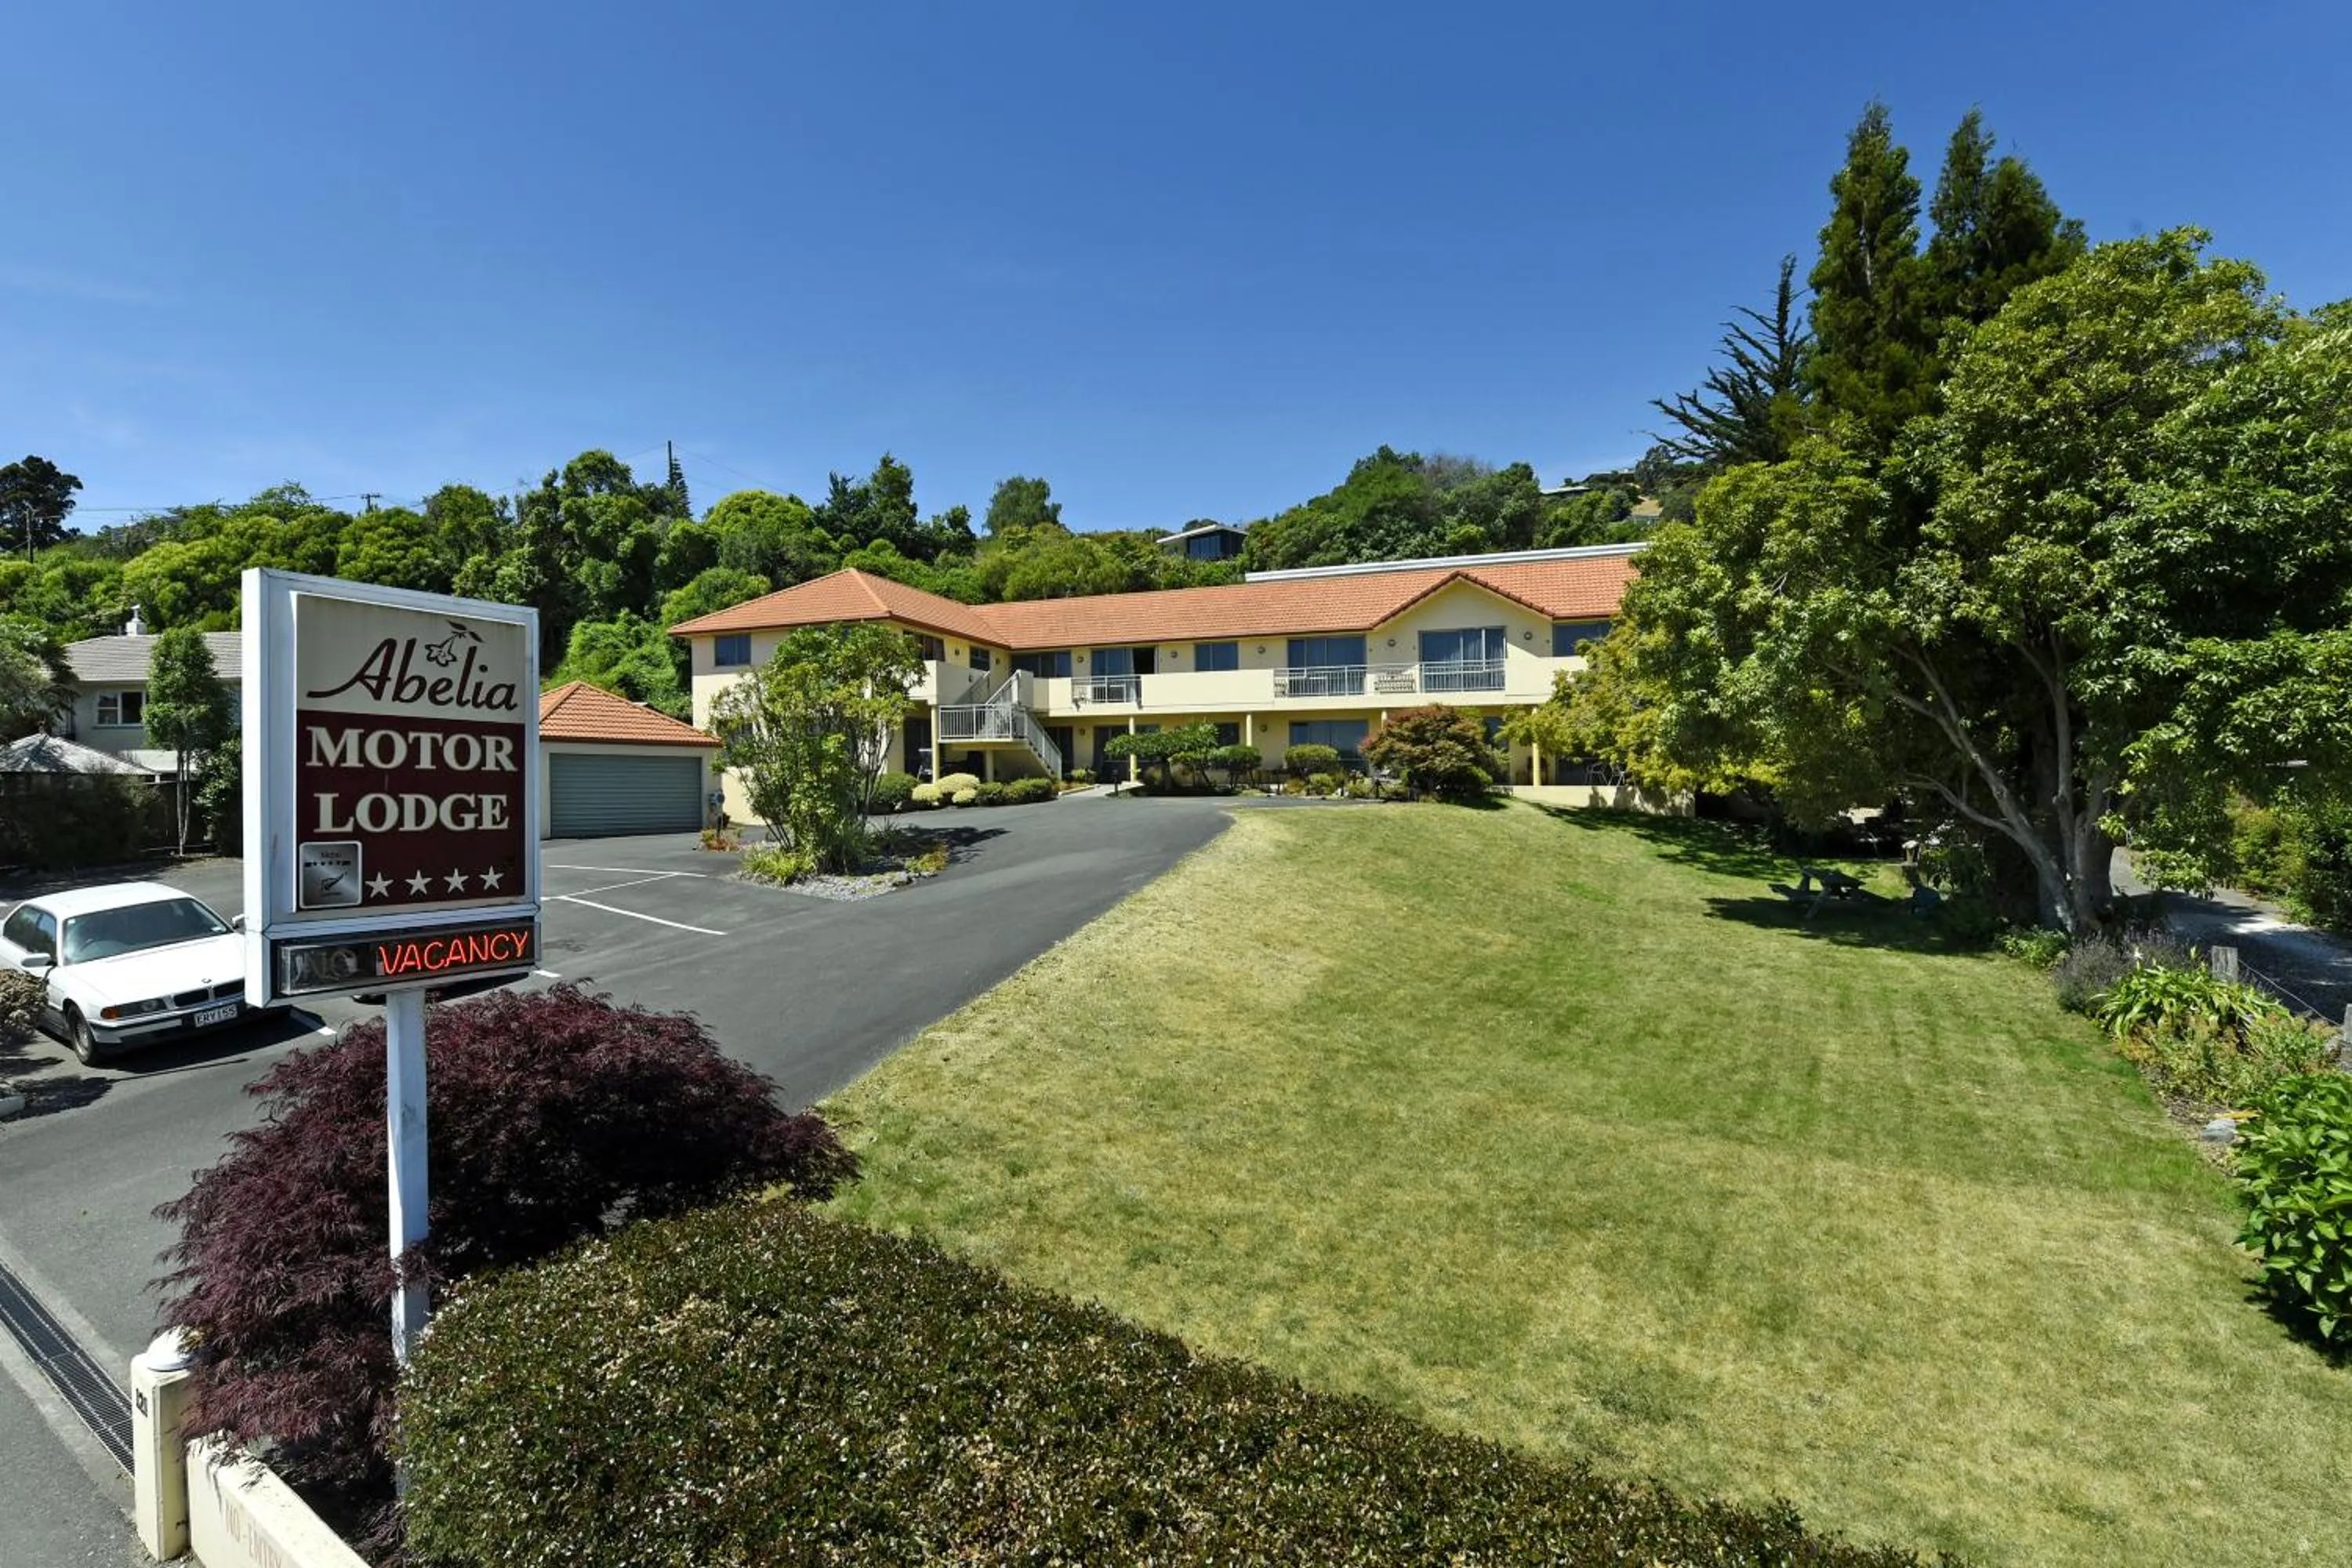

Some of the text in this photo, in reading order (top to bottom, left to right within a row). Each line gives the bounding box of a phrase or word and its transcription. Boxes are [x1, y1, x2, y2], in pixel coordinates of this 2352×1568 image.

[307, 637, 517, 710] Abelia
[306, 726, 517, 771] MOTOR
[314, 793, 509, 833] LODGE
[300, 931, 529, 980] NO VACANCY
